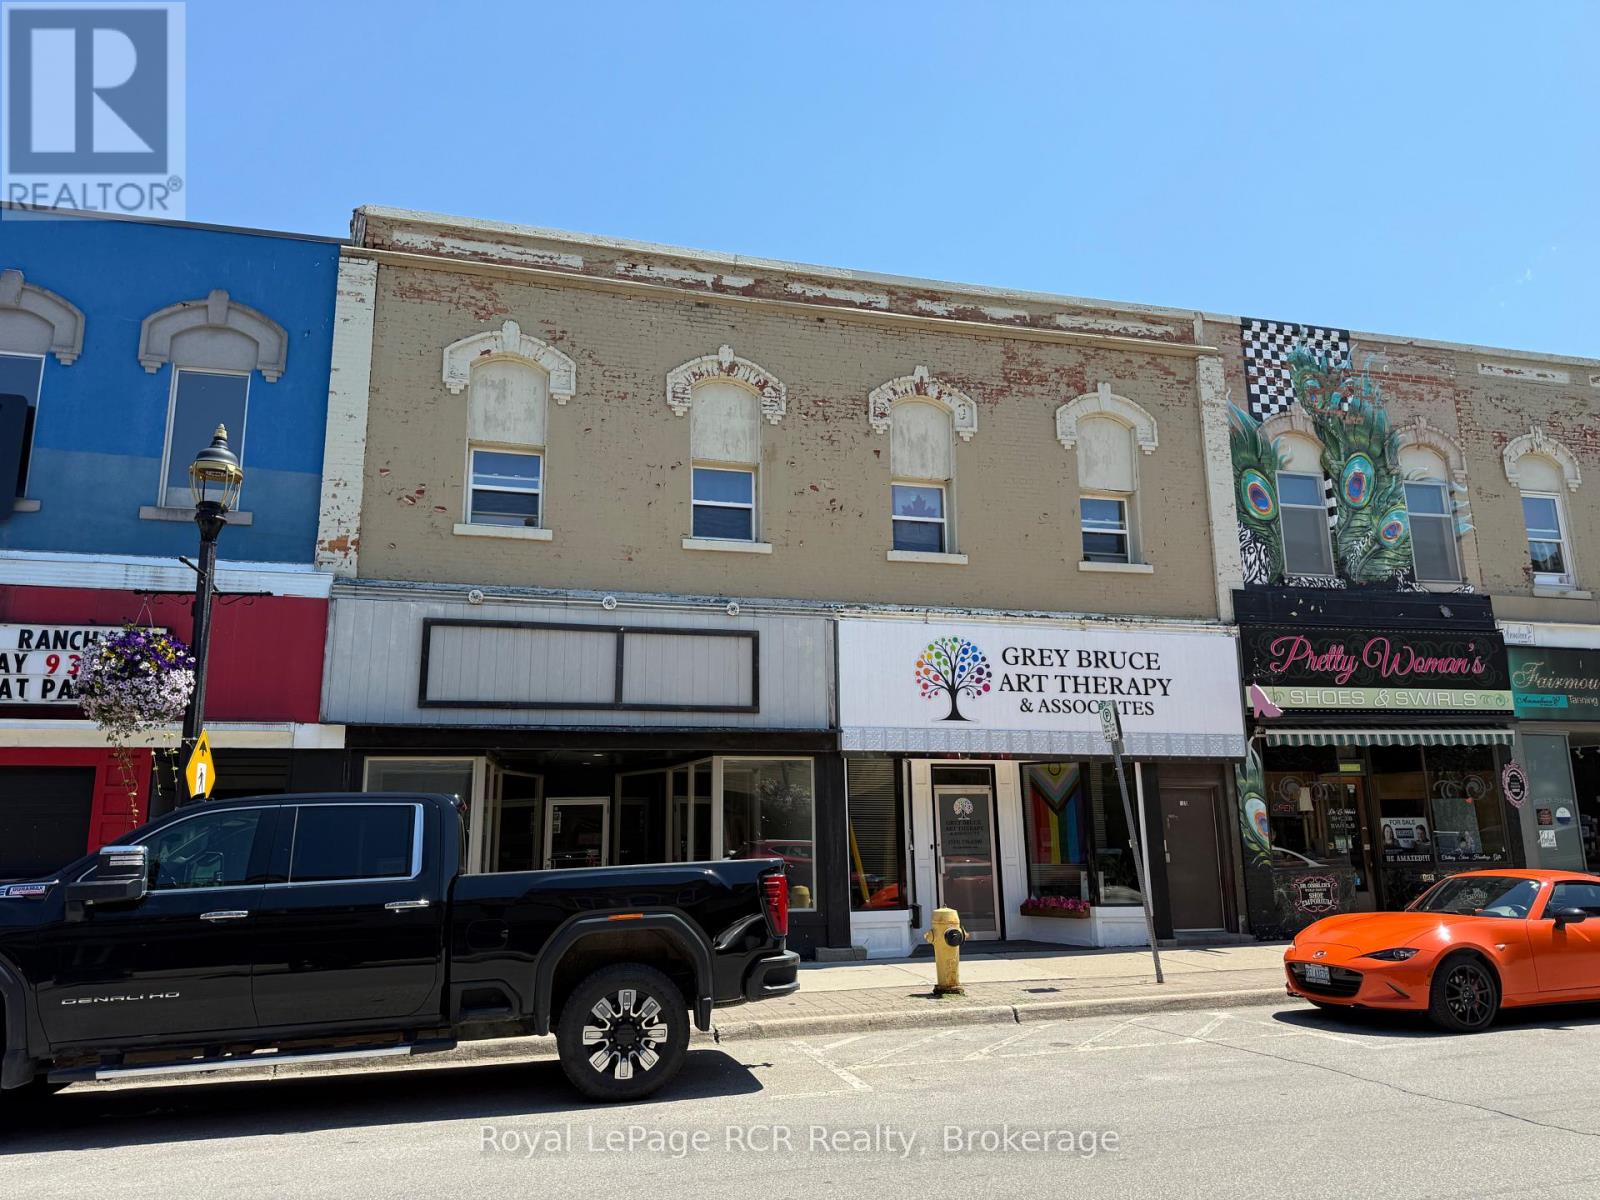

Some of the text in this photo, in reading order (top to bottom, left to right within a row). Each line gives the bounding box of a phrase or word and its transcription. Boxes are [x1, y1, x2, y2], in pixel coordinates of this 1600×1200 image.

[1001, 647, 1161, 670] GREY BRUCE
[1269, 635, 1485, 685] Pretty Woman's
[998, 673, 1172, 696] ART THERAPY
[1019, 698, 1155, 716] & ASSOCTES
[1290, 688, 1477, 708] SHOES & SWIRLS
[1568, 694, 1598, 707] Tanning
[61, 991, 180, 1005] DENALI HD
